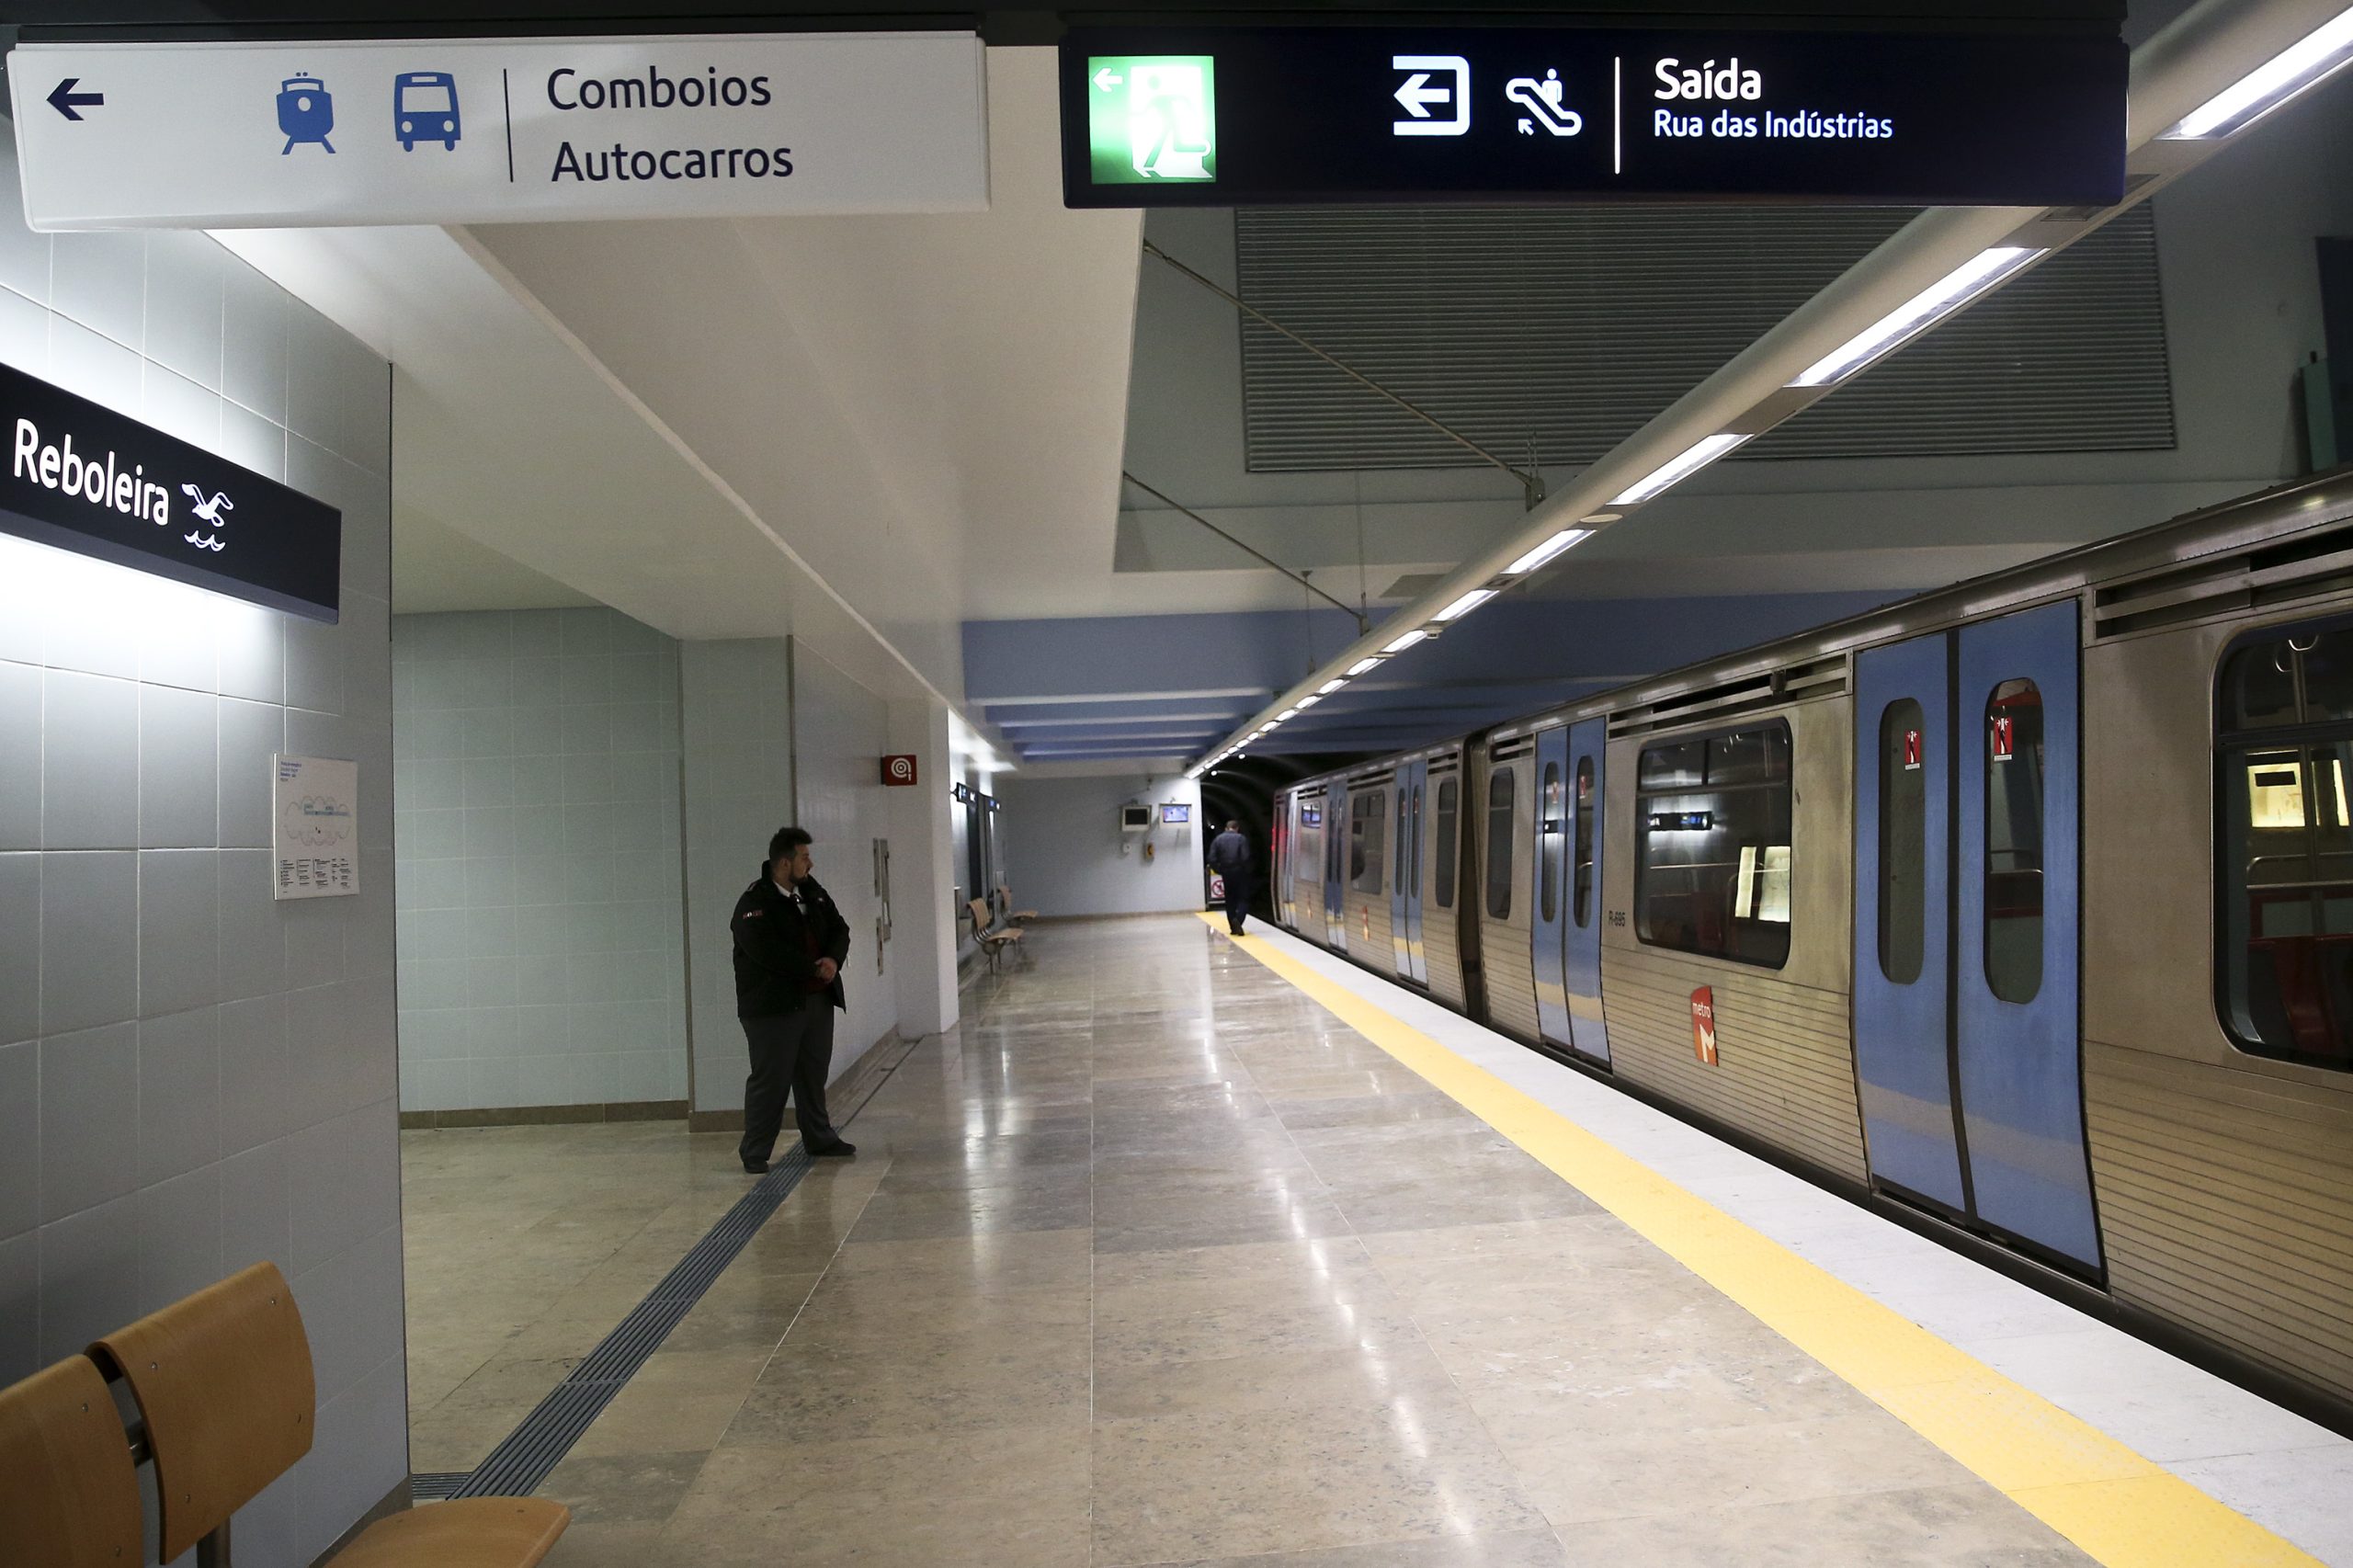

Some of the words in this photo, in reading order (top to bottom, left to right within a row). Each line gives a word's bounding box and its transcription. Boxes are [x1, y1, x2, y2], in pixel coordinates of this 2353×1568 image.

[547, 64, 772, 111] Comboios
[1654, 57, 1762, 100] Saída
[1654, 108, 1703, 138] Rua
[1711, 108, 1758, 138] das
[1765, 108, 1893, 139] Indústrias
[551, 141, 794, 182] Autocarros
[13, 419, 171, 527] Reboleira
[1692, 1002, 1711, 1018] metro
